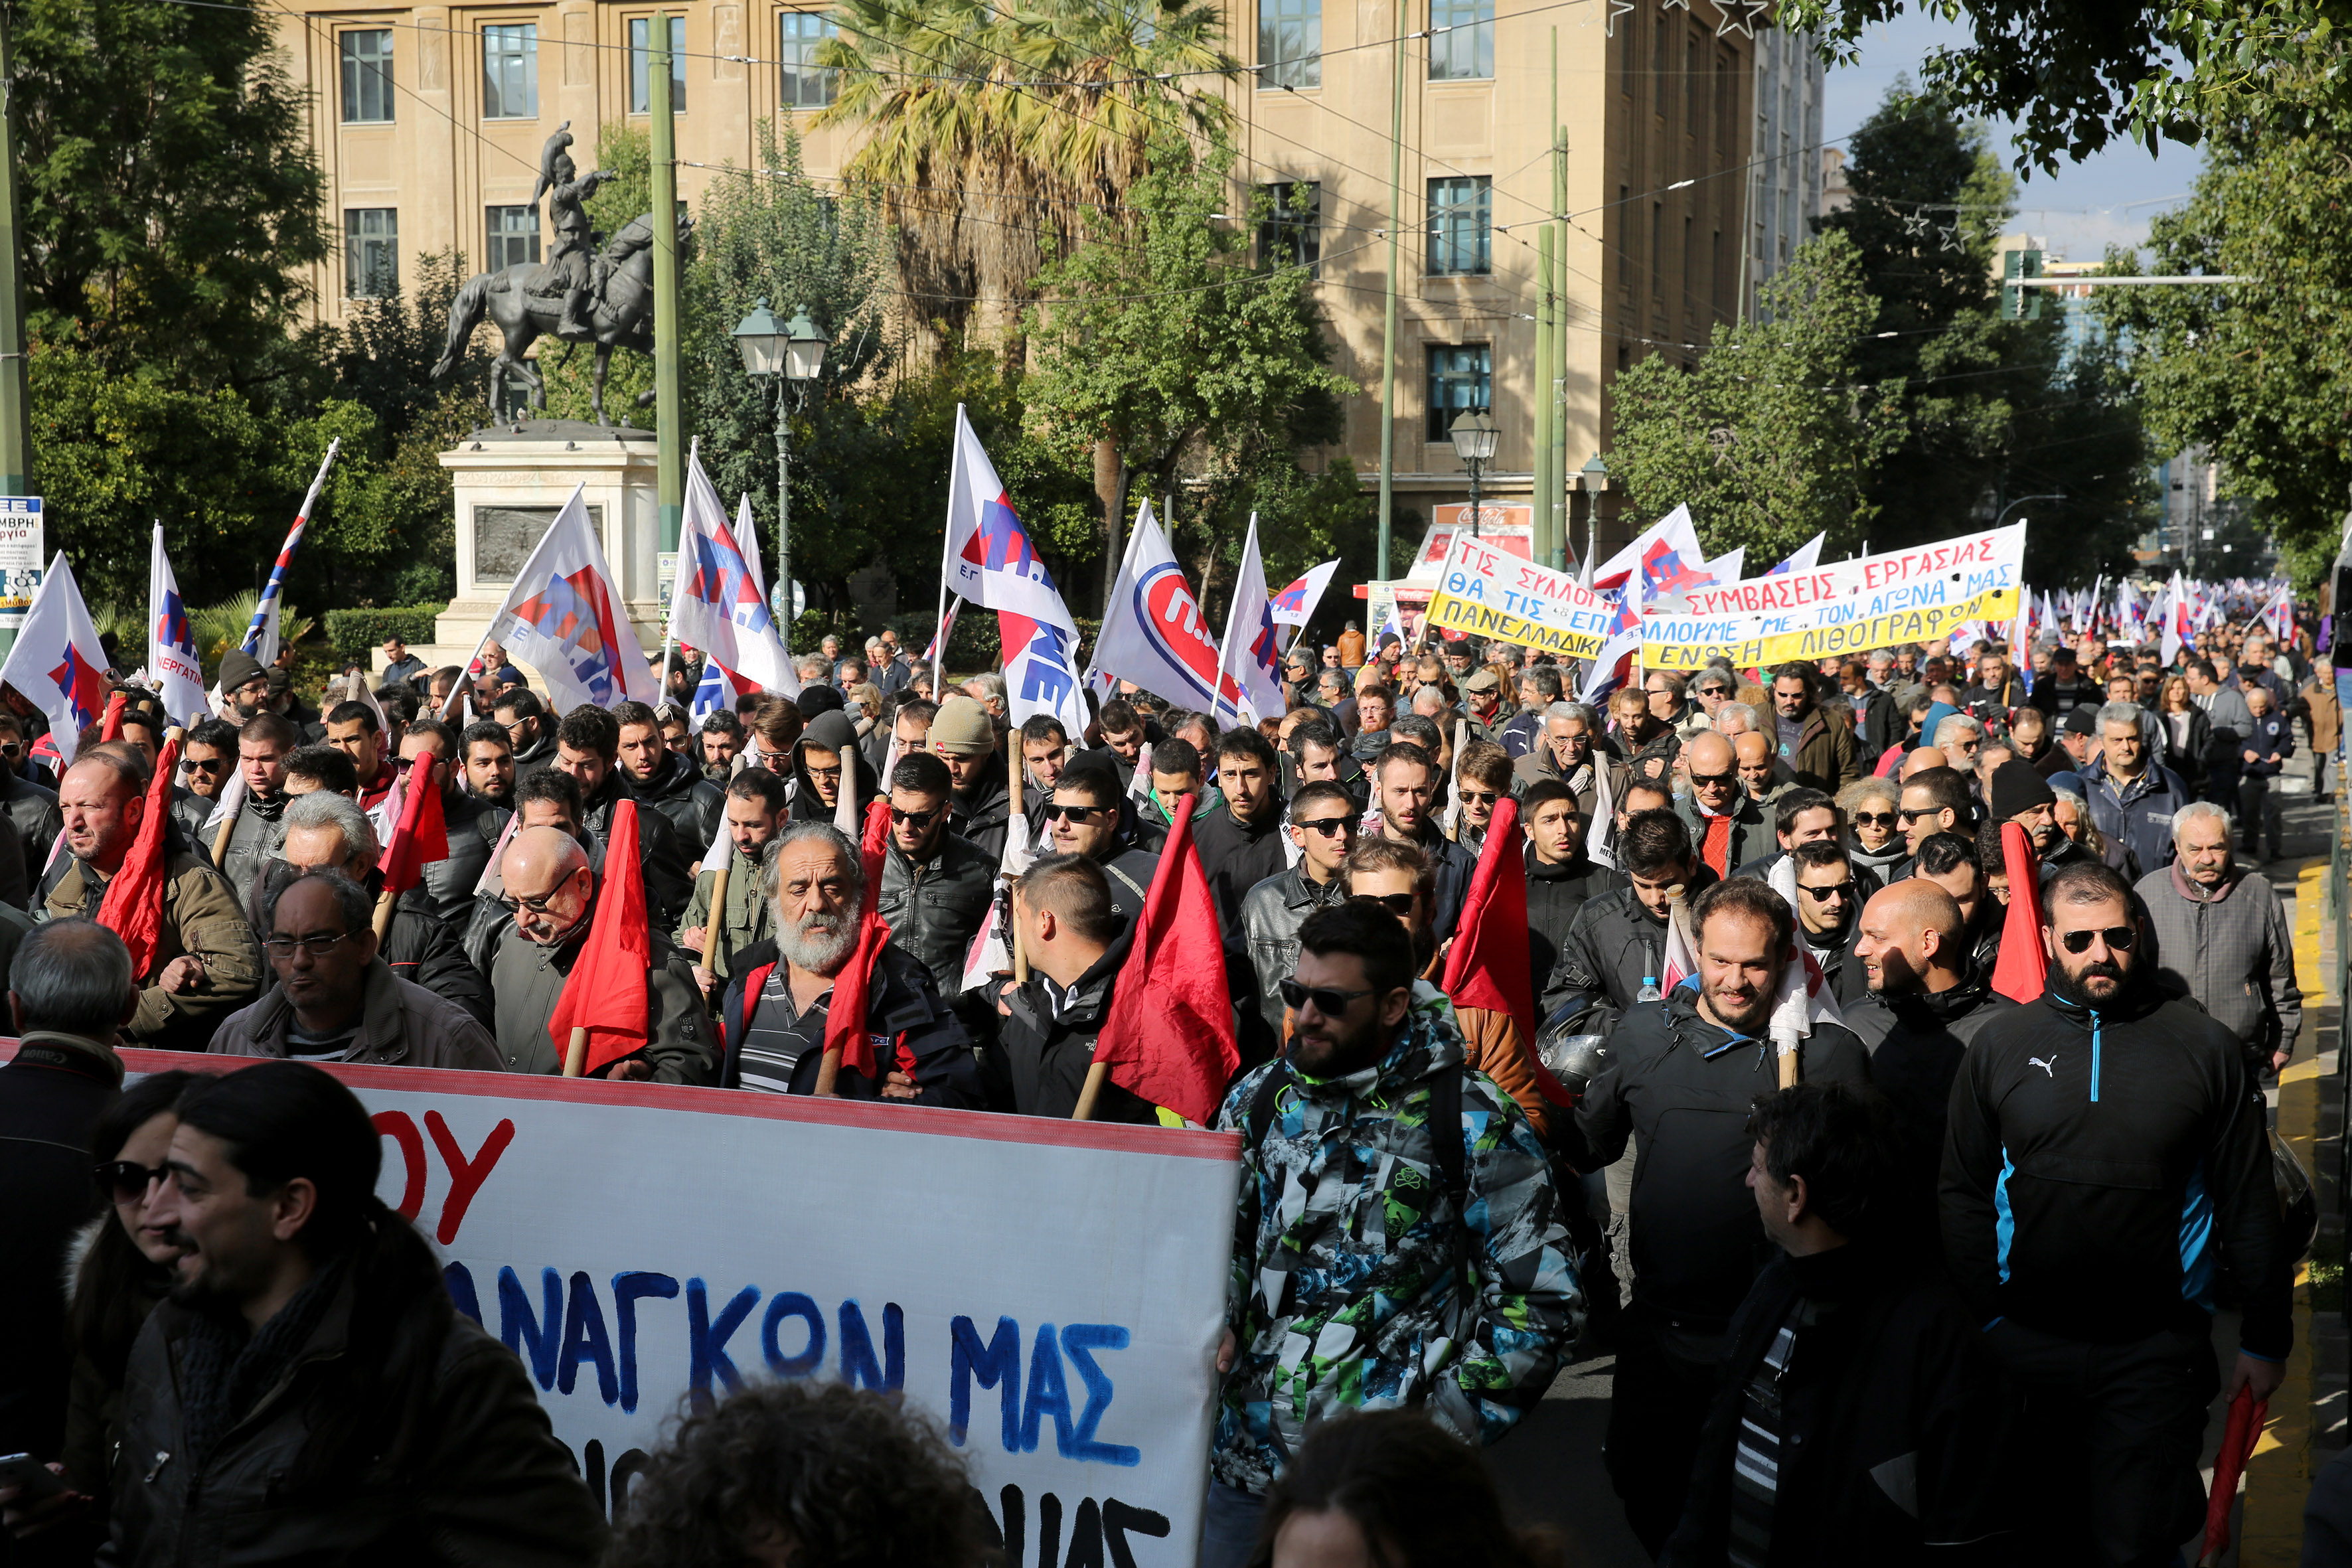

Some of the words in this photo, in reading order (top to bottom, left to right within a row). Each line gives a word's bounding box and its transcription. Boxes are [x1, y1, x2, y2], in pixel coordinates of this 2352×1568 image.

[1457, 507, 1508, 524] Coc-Cola
[1448, 572, 1484, 599] ΘΑ
[1504, 590, 1545, 621] ΤΙΣ
[1760, 614, 1798, 635] ΜΕ
[1816, 601, 1856, 625] ΤΟΝ
[1869, 579, 1946, 616] ΑΓΩΝΑ
[1966, 564, 2014, 597] ΜΑΣ
[1461, 541, 1500, 577] ΤΙΣ
[1686, 573, 1837, 615] ΣΥΜΒΑΣΕΙΣ
[1864, 536, 1996, 589] ΕΡΓΑΣΙΑΣ
[22, 1049, 67, 1063] Canon
[949, 1314, 1141, 1468] ΜΑΣ
